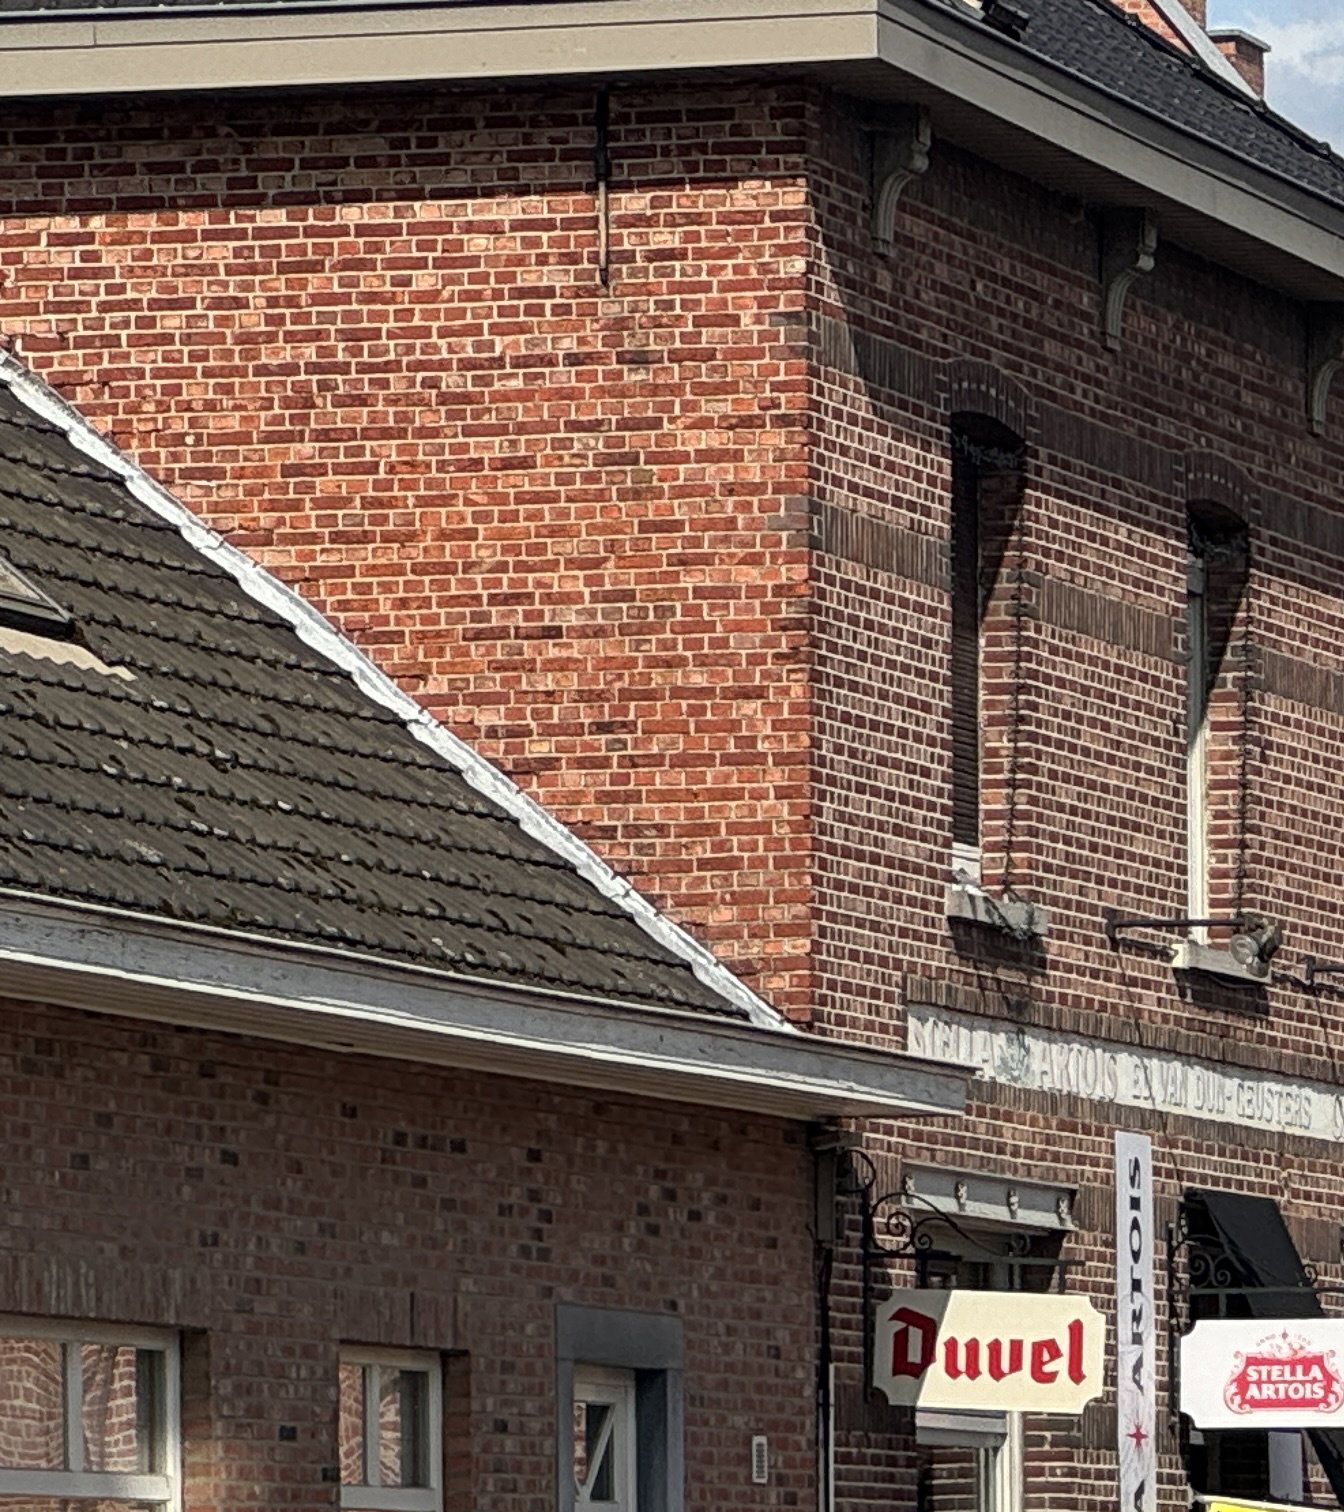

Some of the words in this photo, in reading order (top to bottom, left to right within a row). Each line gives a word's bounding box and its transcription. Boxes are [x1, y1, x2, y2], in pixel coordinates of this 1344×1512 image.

[1031, 1037, 1118, 1101] ARTOIS
[1160, 1060, 1188, 1107] VAN
[1129, 1156, 1145, 1397] ARTOIS
[888, 1307, 1089, 1386] Duvel
[1246, 1364, 1325, 1382] STELLA
[1244, 1382, 1326, 1400] ARTOIS
